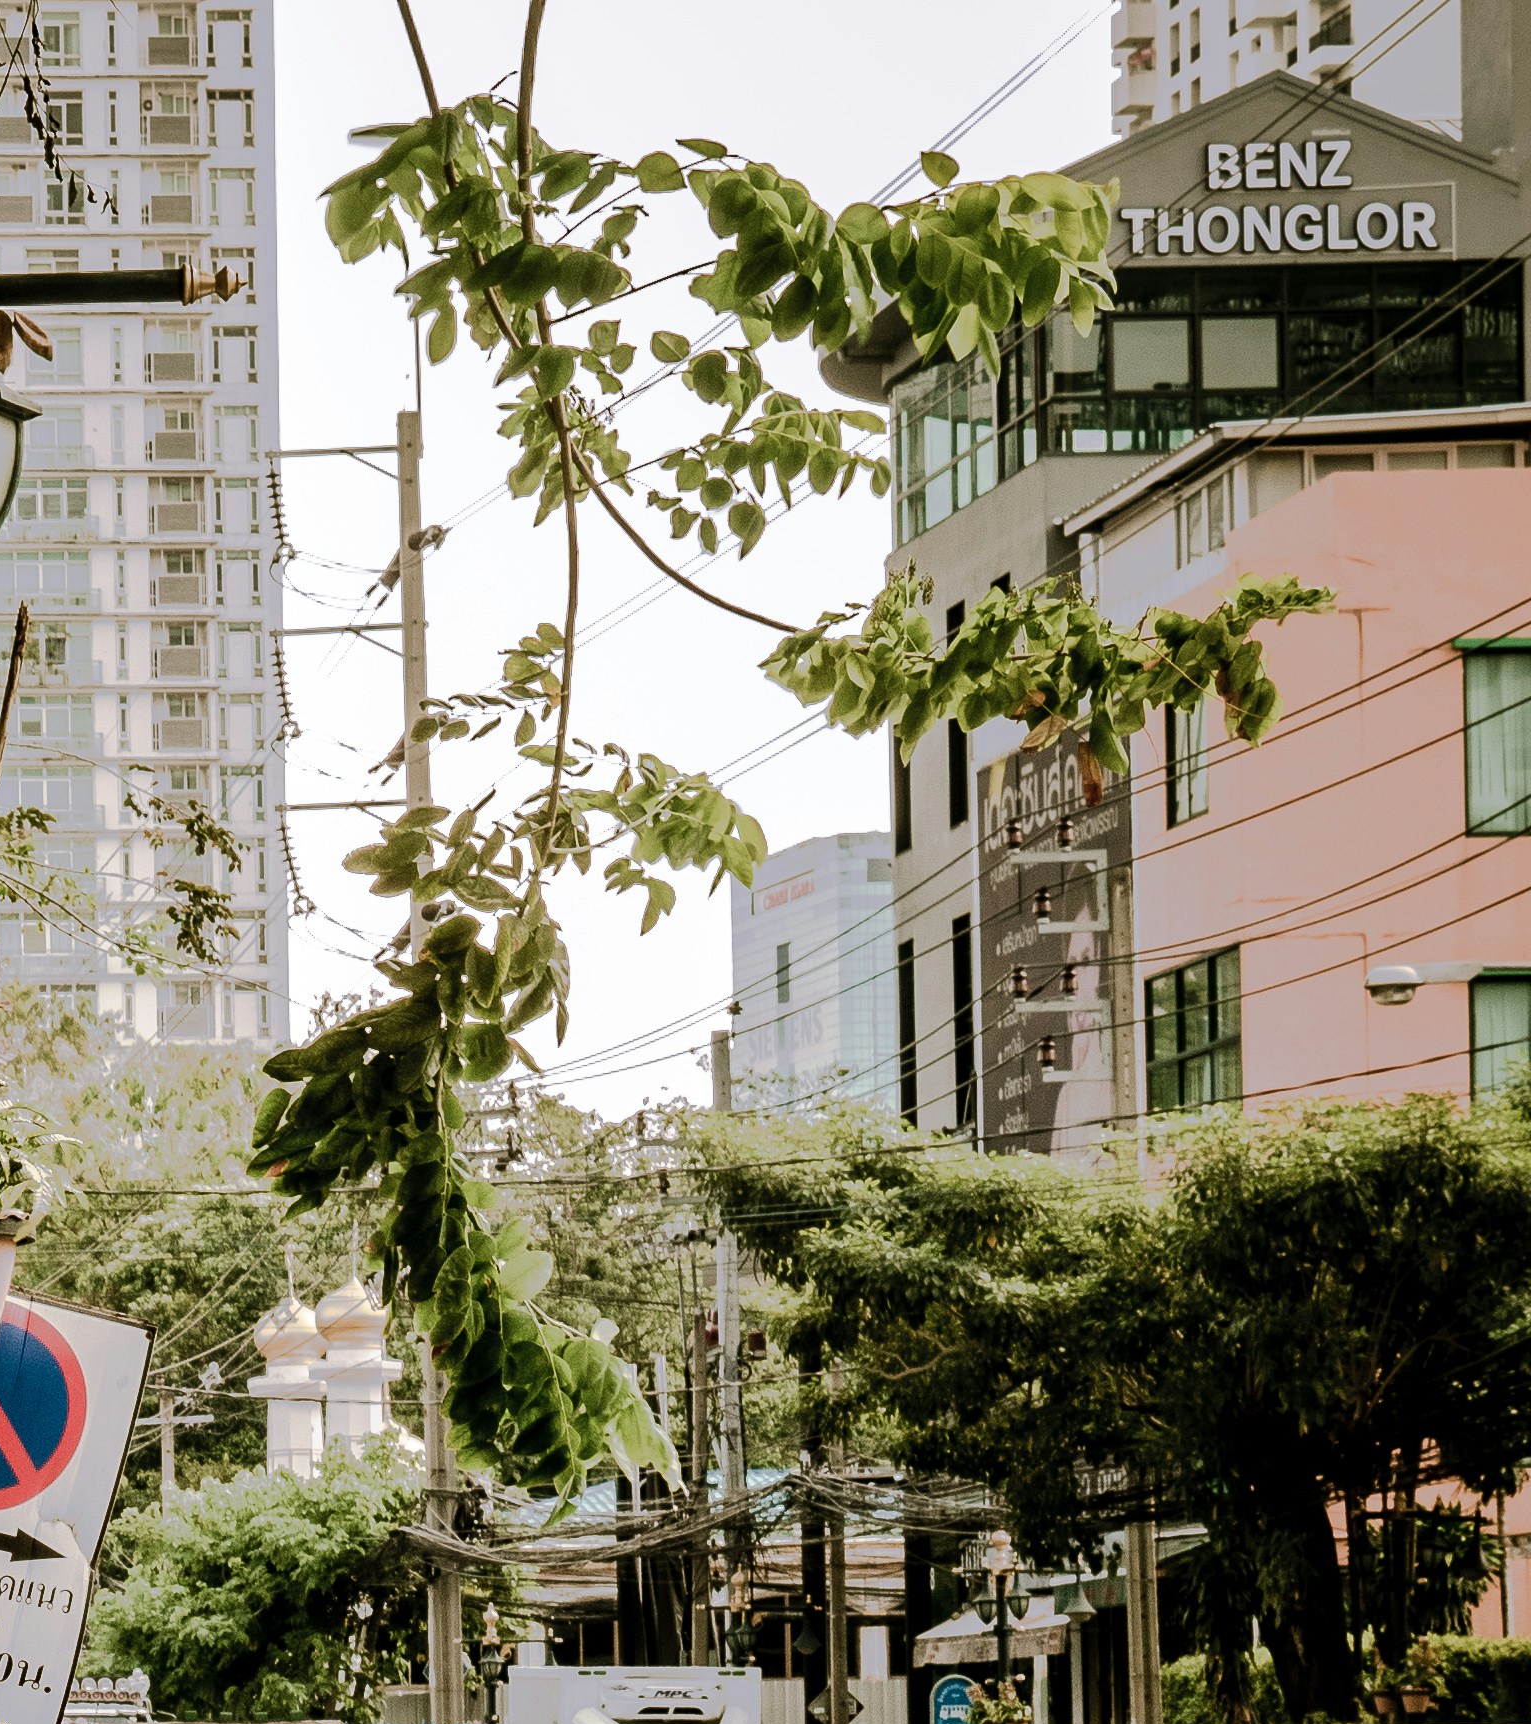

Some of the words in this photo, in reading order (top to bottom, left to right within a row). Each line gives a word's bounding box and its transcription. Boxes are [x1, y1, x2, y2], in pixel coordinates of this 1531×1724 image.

[1208, 140, 1352, 189] BENZ
[1121, 201, 1437, 254] THONGLOR
[747, 1006, 824, 1064] SIEENS
[653, 1689, 694, 1699] MPC
